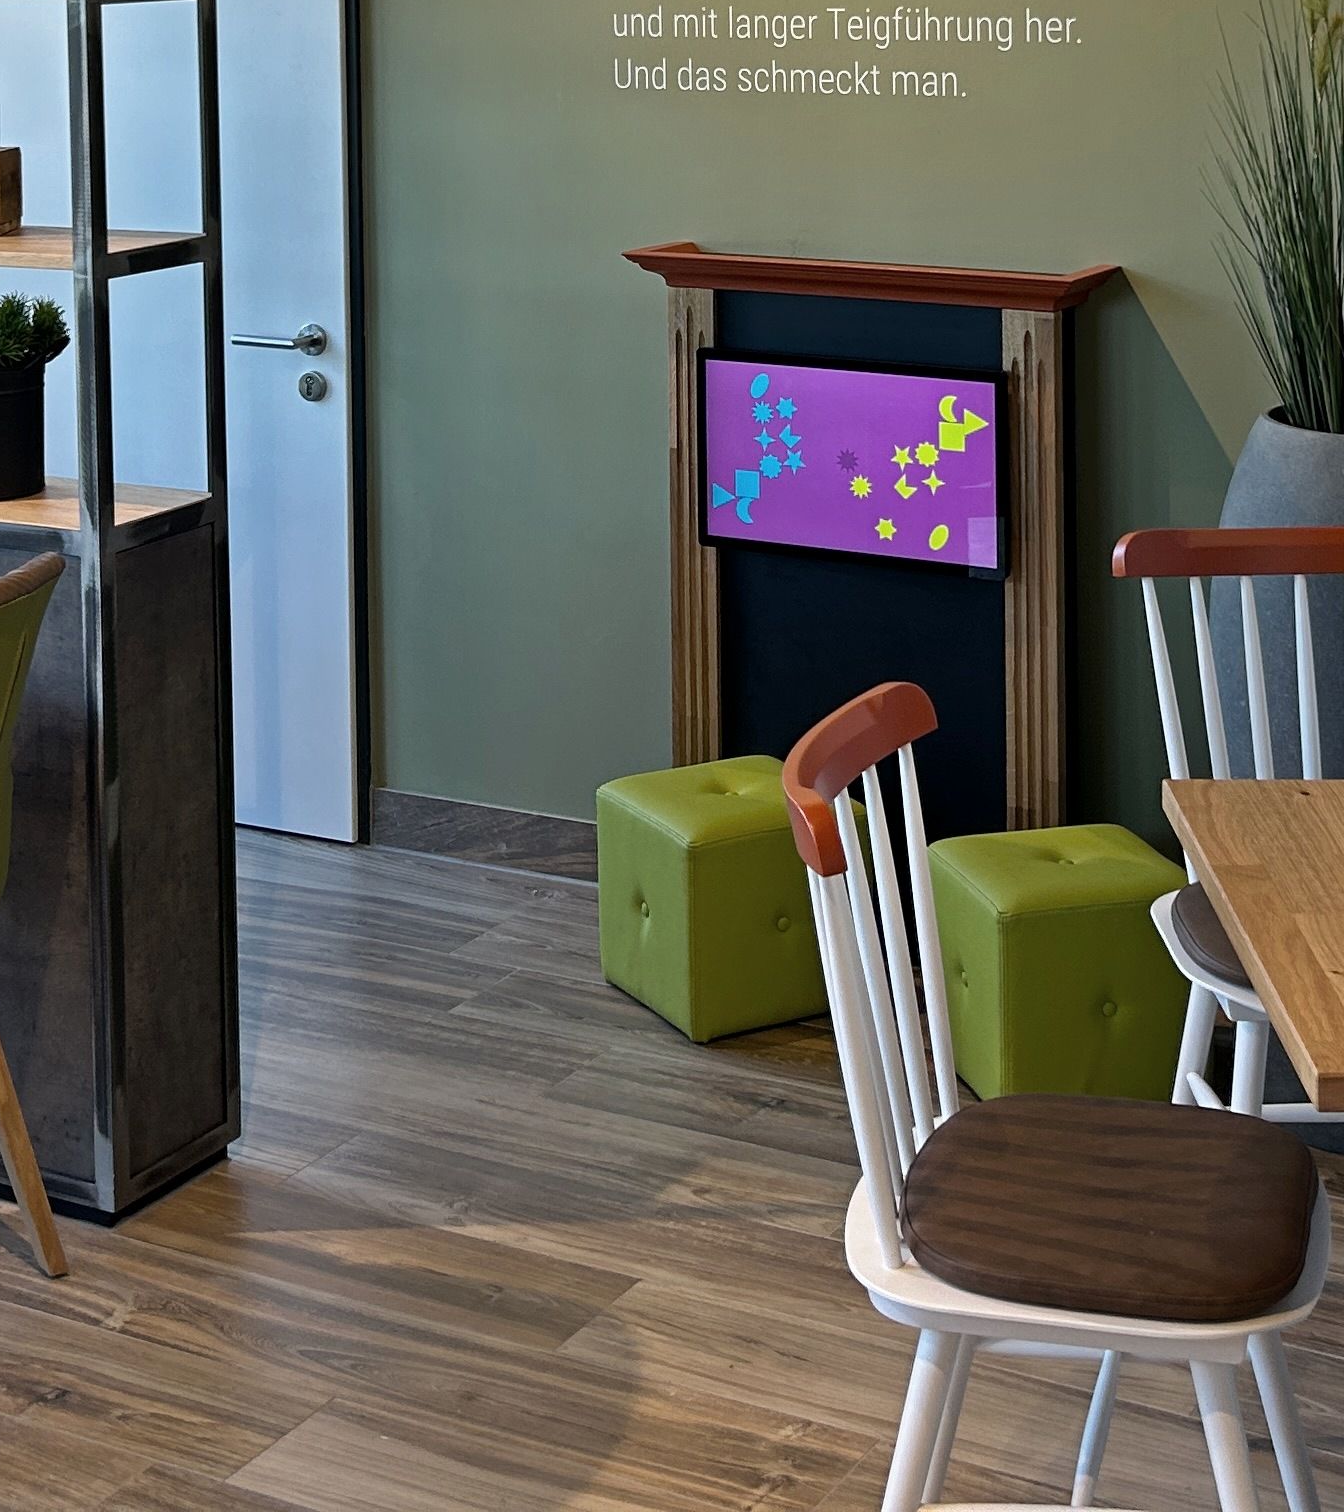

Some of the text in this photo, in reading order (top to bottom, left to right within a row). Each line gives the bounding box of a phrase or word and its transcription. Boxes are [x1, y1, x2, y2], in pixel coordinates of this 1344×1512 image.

[613, 4, 1082, 52] und mit langer Teigführung her.
[614, 56, 967, 98] Und das schmeckt man.
